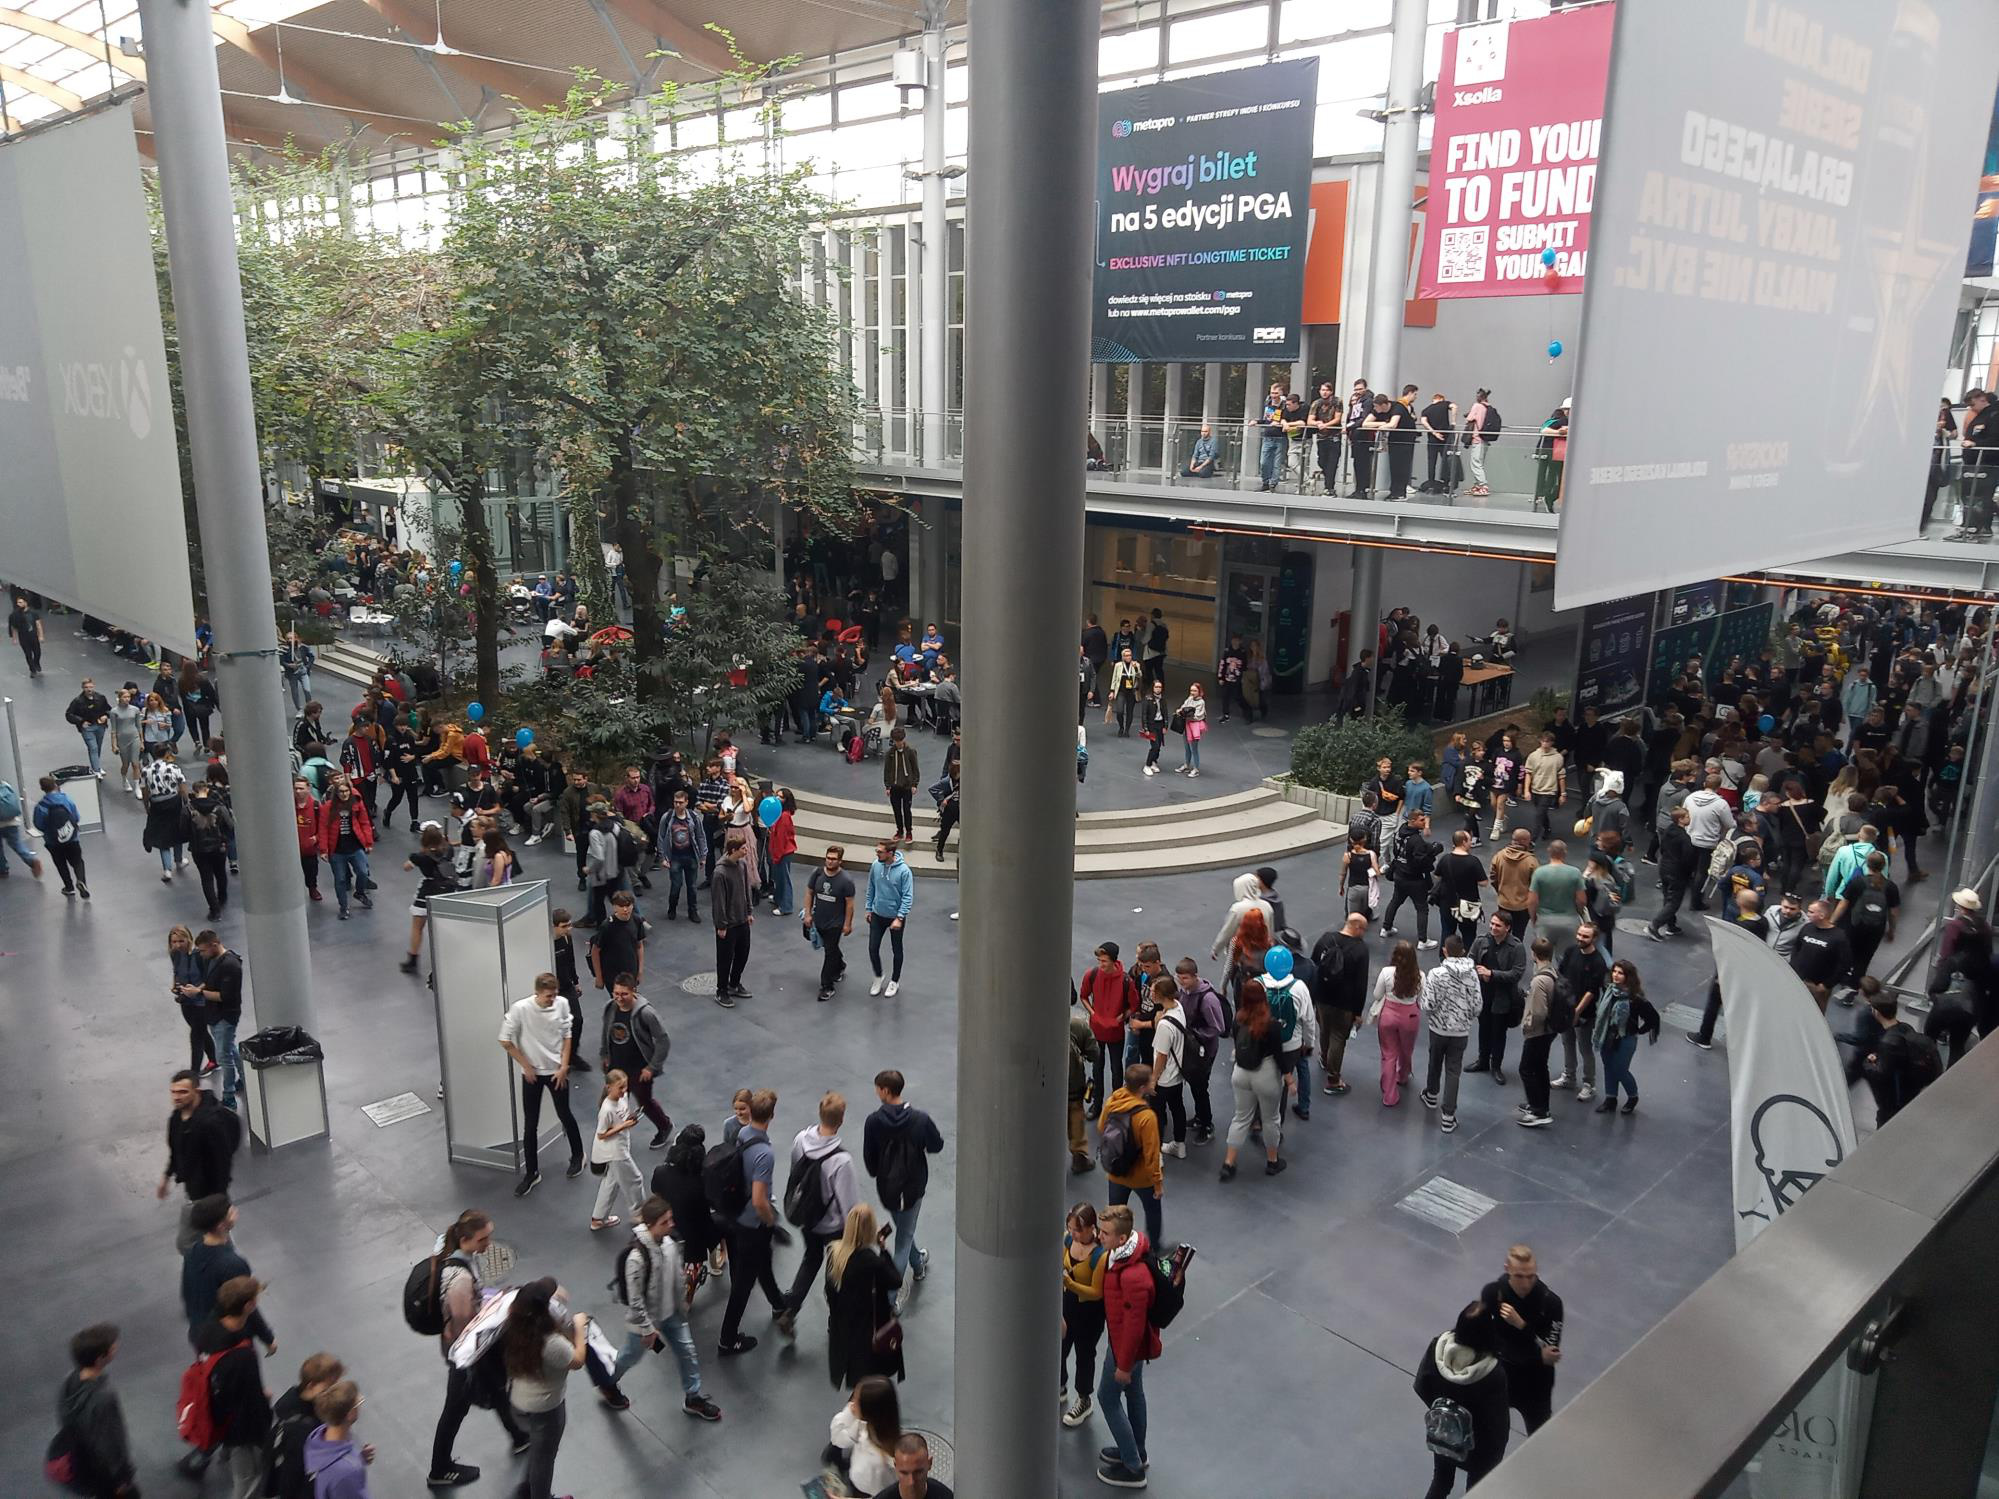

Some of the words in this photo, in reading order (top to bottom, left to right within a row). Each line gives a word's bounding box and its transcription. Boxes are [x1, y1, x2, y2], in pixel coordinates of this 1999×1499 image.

[1452, 86, 1502, 107] Xsolla
[1186, 111, 1214, 123] PARTNER
[1215, 108, 1239, 119] STREFY
[1263, 99, 1301, 112] KONKURSU
[1133, 116, 1175, 132] metapro
[1446, 129, 1521, 173] FIND
[1529, 118, 1602, 164] YOU
[1111, 153, 1195, 196] Wygraj
[1199, 150, 1257, 183] bilet
[1444, 175, 1491, 224] TO
[1110, 208, 1140, 233] na
[1143, 204, 1158, 230] 5
[1162, 193, 1234, 231] edycji
[1238, 191, 1292, 222] PGA
[1496, 221, 1578, 251] SUBMIT
[1109, 254, 1165, 270] EXCLUSIVE
[1166, 252, 1187, 268] NFT
[1188, 249, 1246, 266] LONGTIME
[1248, 246, 1291, 261] TICKET
[1108, 294, 1138, 305] dowiedz
[1138, 293, 1149, 306] się
[1149, 292, 1173, 305] więcej
[1173, 294, 1184, 303] na
[1185, 291, 1211, 302] stoisku
[1225, 290, 1253, 300] metapro
[1108, 308, 1119, 318] lub
[1120, 308, 1130, 317] na
[1131, 305, 1241, 318] www.metaprowallet.com/pga
[1253, 327, 1286, 340] PGA
